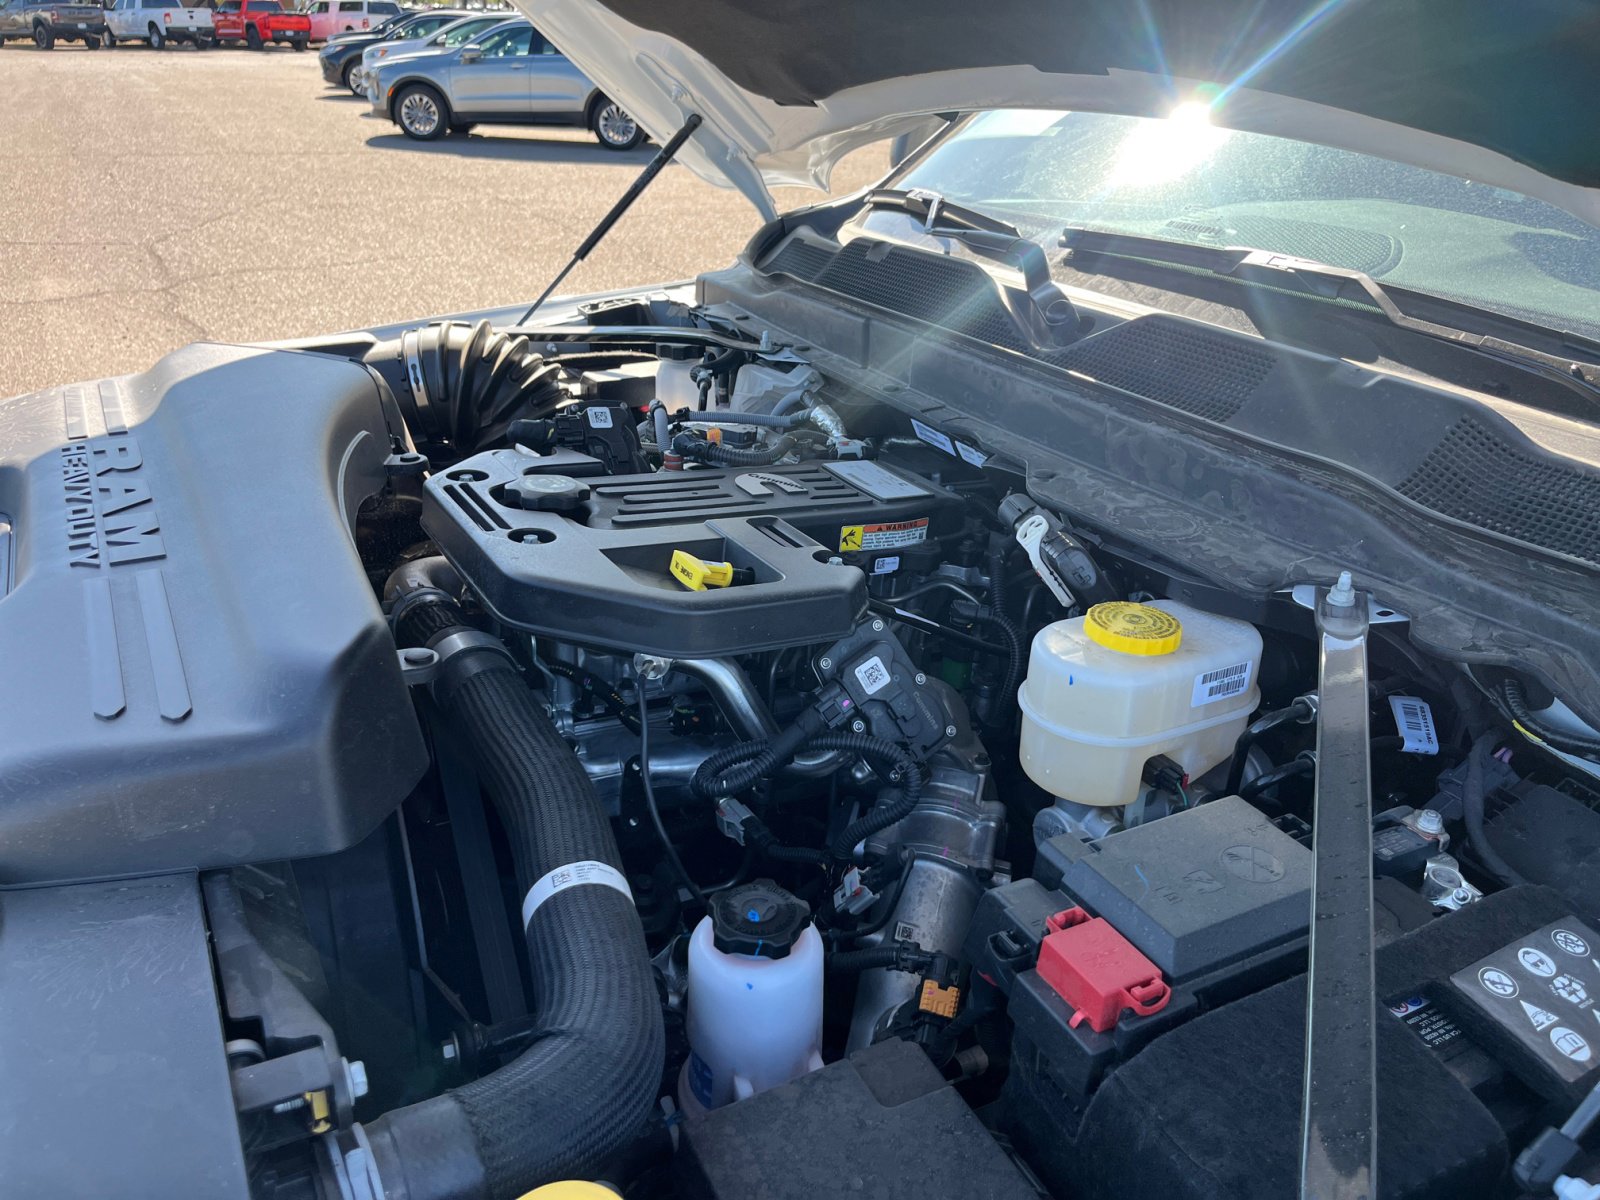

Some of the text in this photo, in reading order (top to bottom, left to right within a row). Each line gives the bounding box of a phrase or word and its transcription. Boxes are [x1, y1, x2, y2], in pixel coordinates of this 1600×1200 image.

[61, 443, 101, 568] HEAVY DUTY
[93, 436, 167, 567] RAM
[885, 520, 918, 531] WARNING
